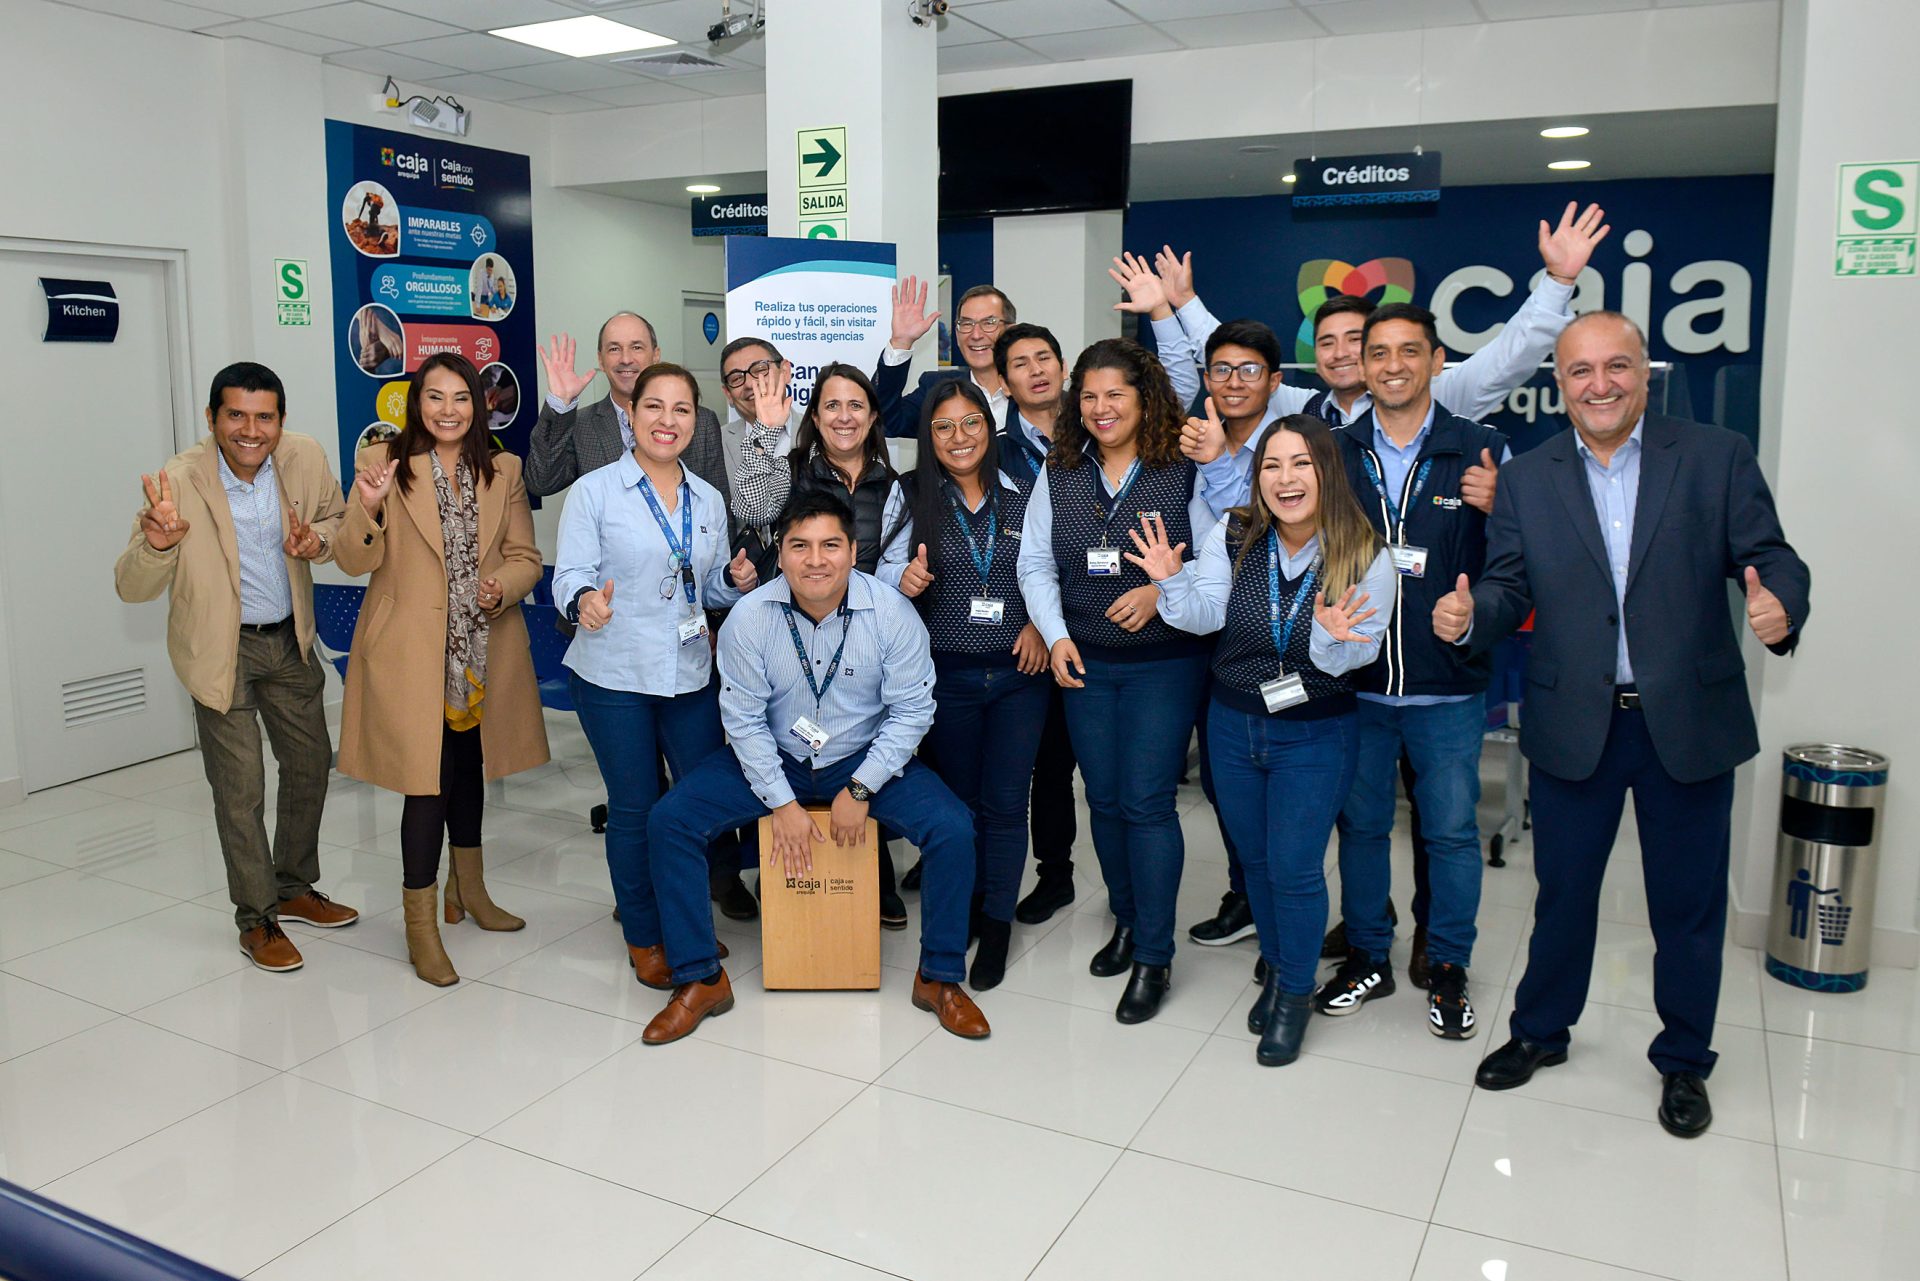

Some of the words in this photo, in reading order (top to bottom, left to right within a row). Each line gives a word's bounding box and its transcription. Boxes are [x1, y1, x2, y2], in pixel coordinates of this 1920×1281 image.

[396, 153, 428, 173] caja
[441, 158, 461, 173] Caja
[441, 173, 474, 186] sentido
[1322, 165, 1410, 185] Créditos
[802, 194, 845, 210] SALIDA
[1852, 169, 1905, 231] S
[710, 203, 769, 219] Créditos
[408, 216, 461, 233] IMPARABLES
[281, 263, 304, 299] S
[405, 280, 463, 295] ORGULLOSOS
[62, 304, 106, 317] Kitchen
[754, 300, 796, 312] Realiza
[799, 302, 815, 312] tus
[817, 302, 878, 314] operaciones
[756, 315, 791, 328] rápido
[794, 318, 801, 328] y
[803, 316, 828, 328] fácil,
[830, 316, 845, 327] sin
[847, 317, 877, 327] visitar
[771, 331, 817, 341] nuestras
[820, 331, 864, 343] agencias
[418, 344, 463, 356] HUMANOS
[797, 877, 821, 890] caja
